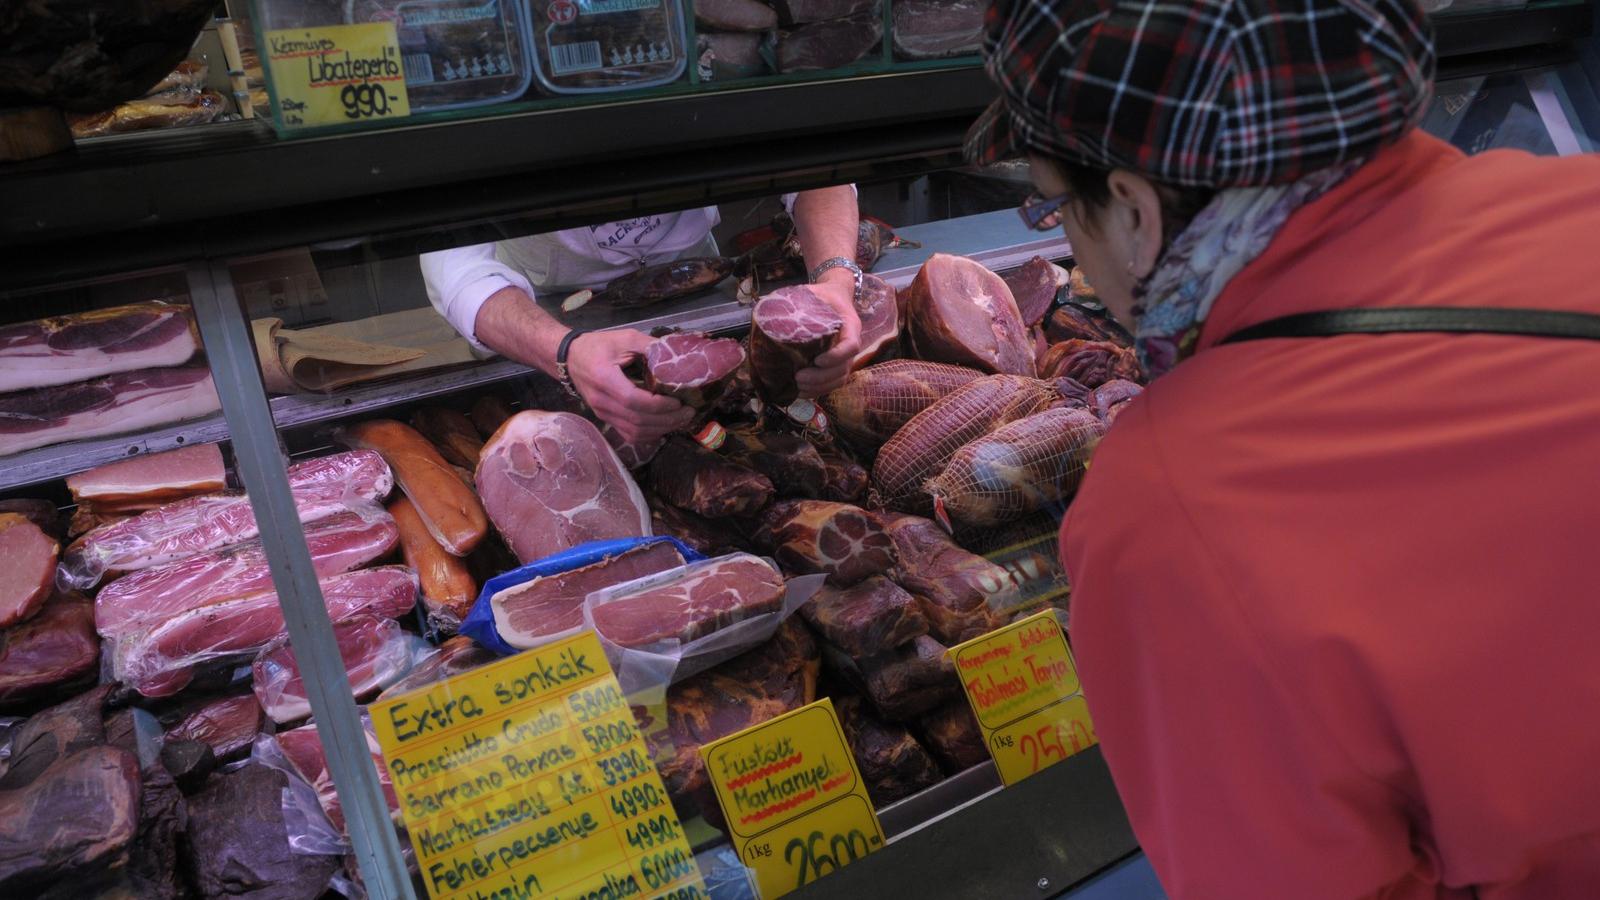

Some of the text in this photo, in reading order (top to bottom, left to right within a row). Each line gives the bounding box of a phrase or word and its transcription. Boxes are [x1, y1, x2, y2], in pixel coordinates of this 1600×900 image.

[308, 46, 399, 83] Libatepertő
[388, 647, 595, 742] Extra sonkák
[1024, 654, 1069, 687] Tarja
[390, 732, 499, 786] Prosciutto
[502, 709, 562, 744] Crudo
[417, 791, 551, 857] Marhaszegy
[428, 810, 598, 894] Fehérpecsenye
